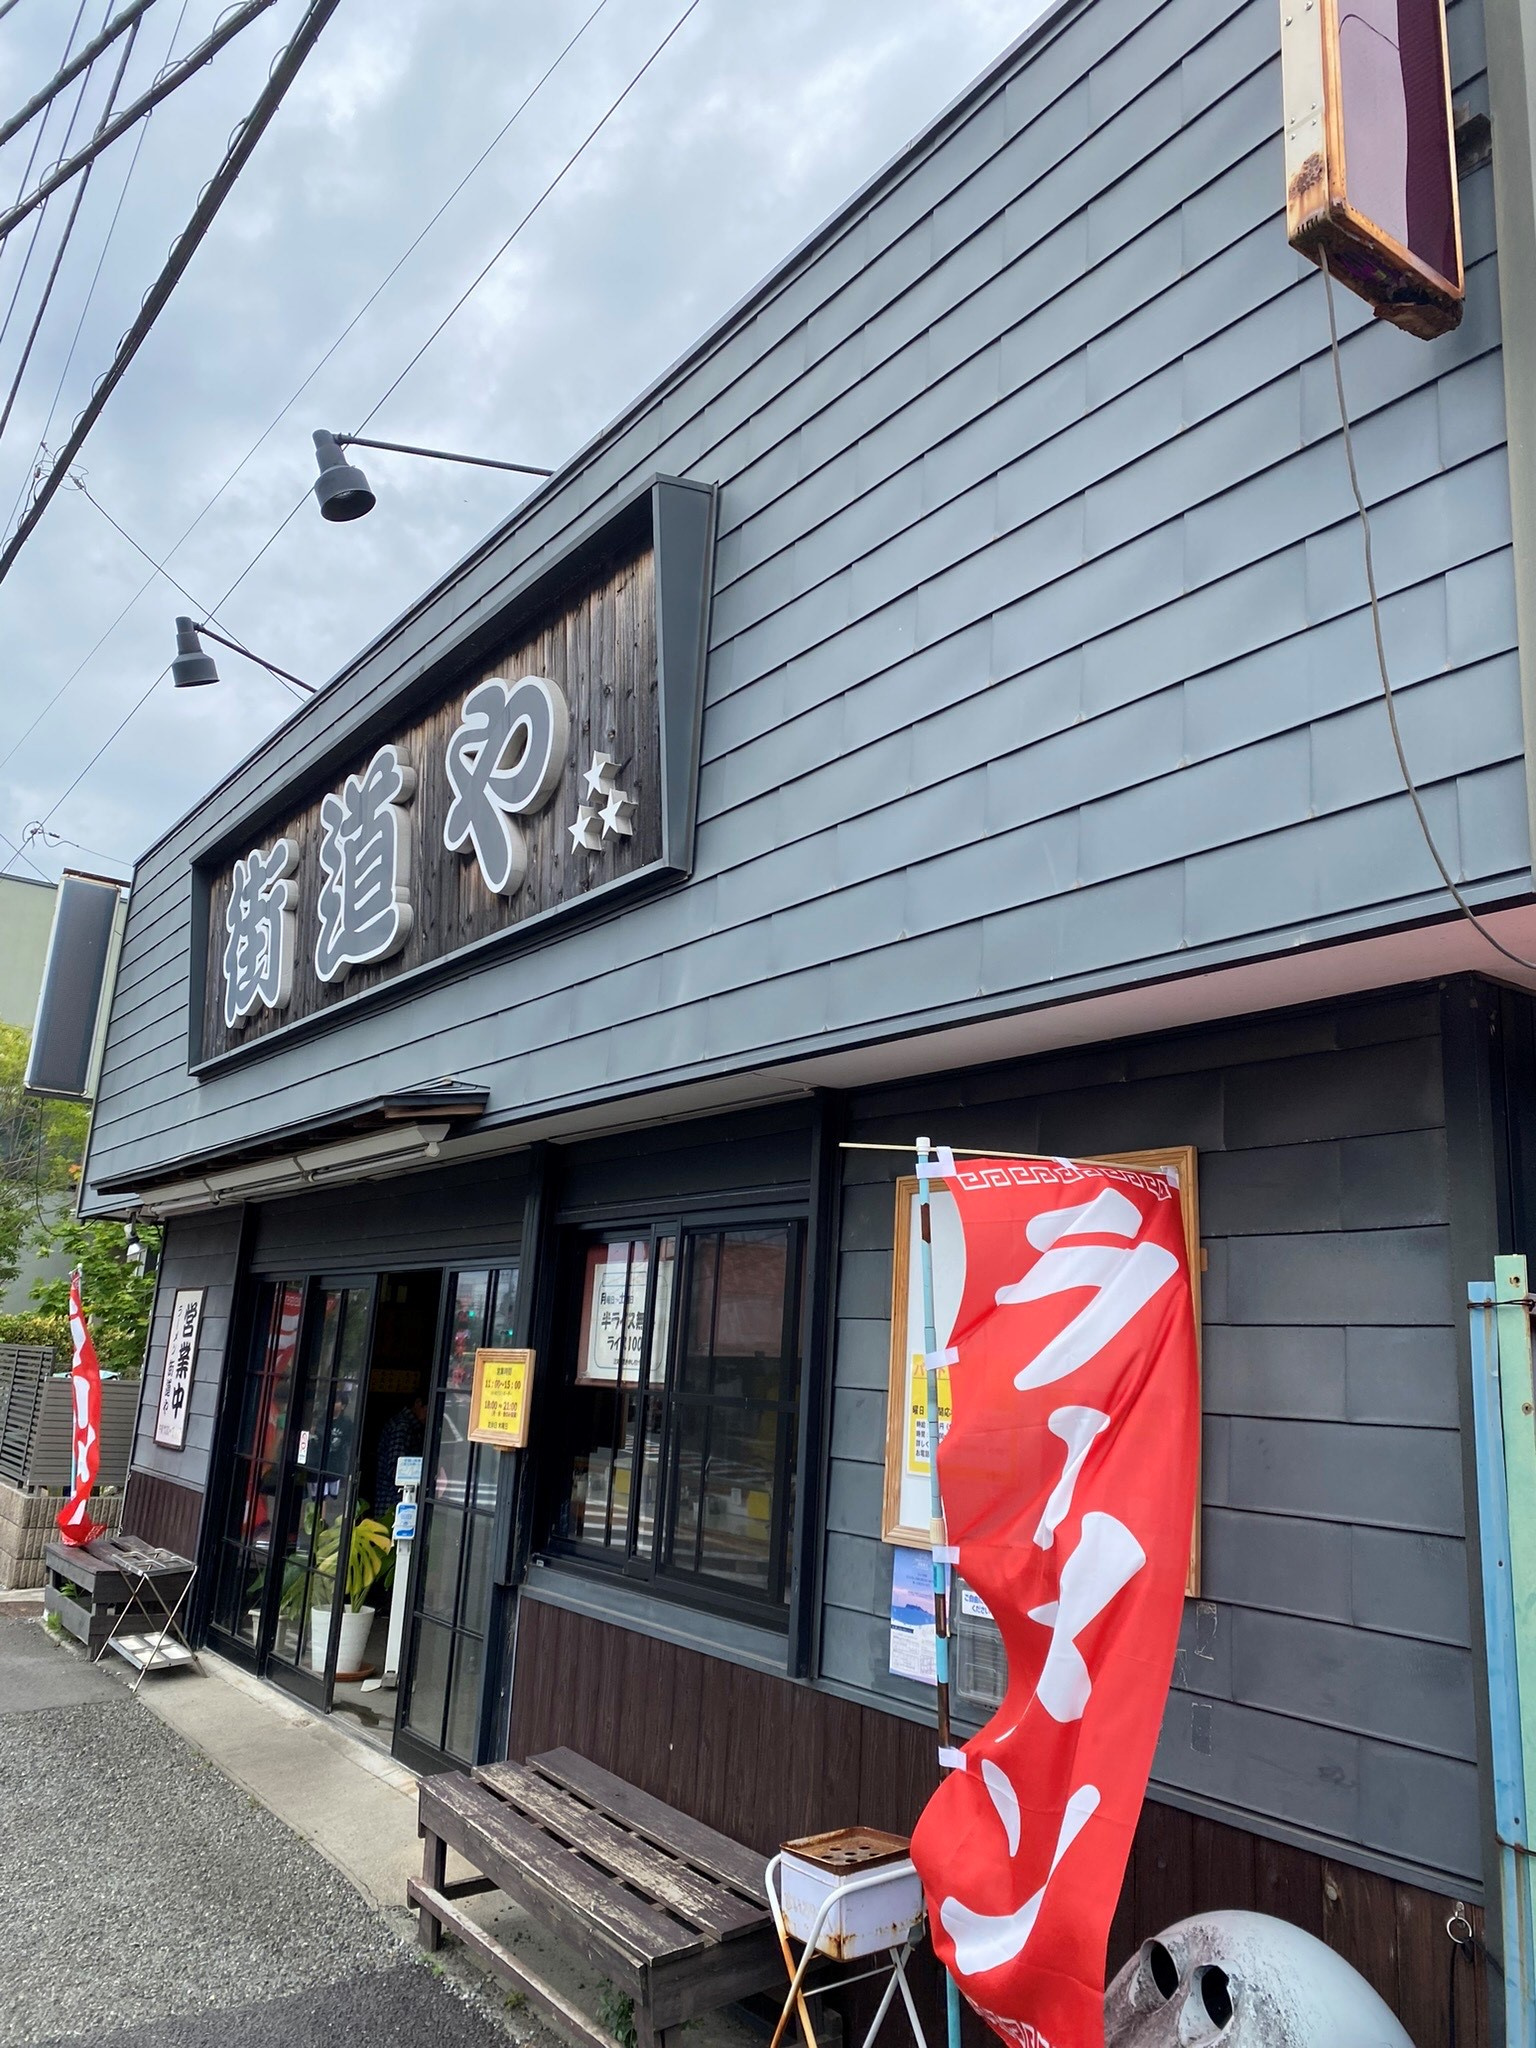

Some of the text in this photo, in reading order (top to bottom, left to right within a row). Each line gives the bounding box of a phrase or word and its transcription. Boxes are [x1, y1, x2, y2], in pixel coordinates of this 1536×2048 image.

[224, 675, 568, 1030] 街道や
[171, 1301, 198, 1419] 営業中
[914, 1362, 946, 1378] パト
[940, 1187, 1181, 1976] ラーメン
